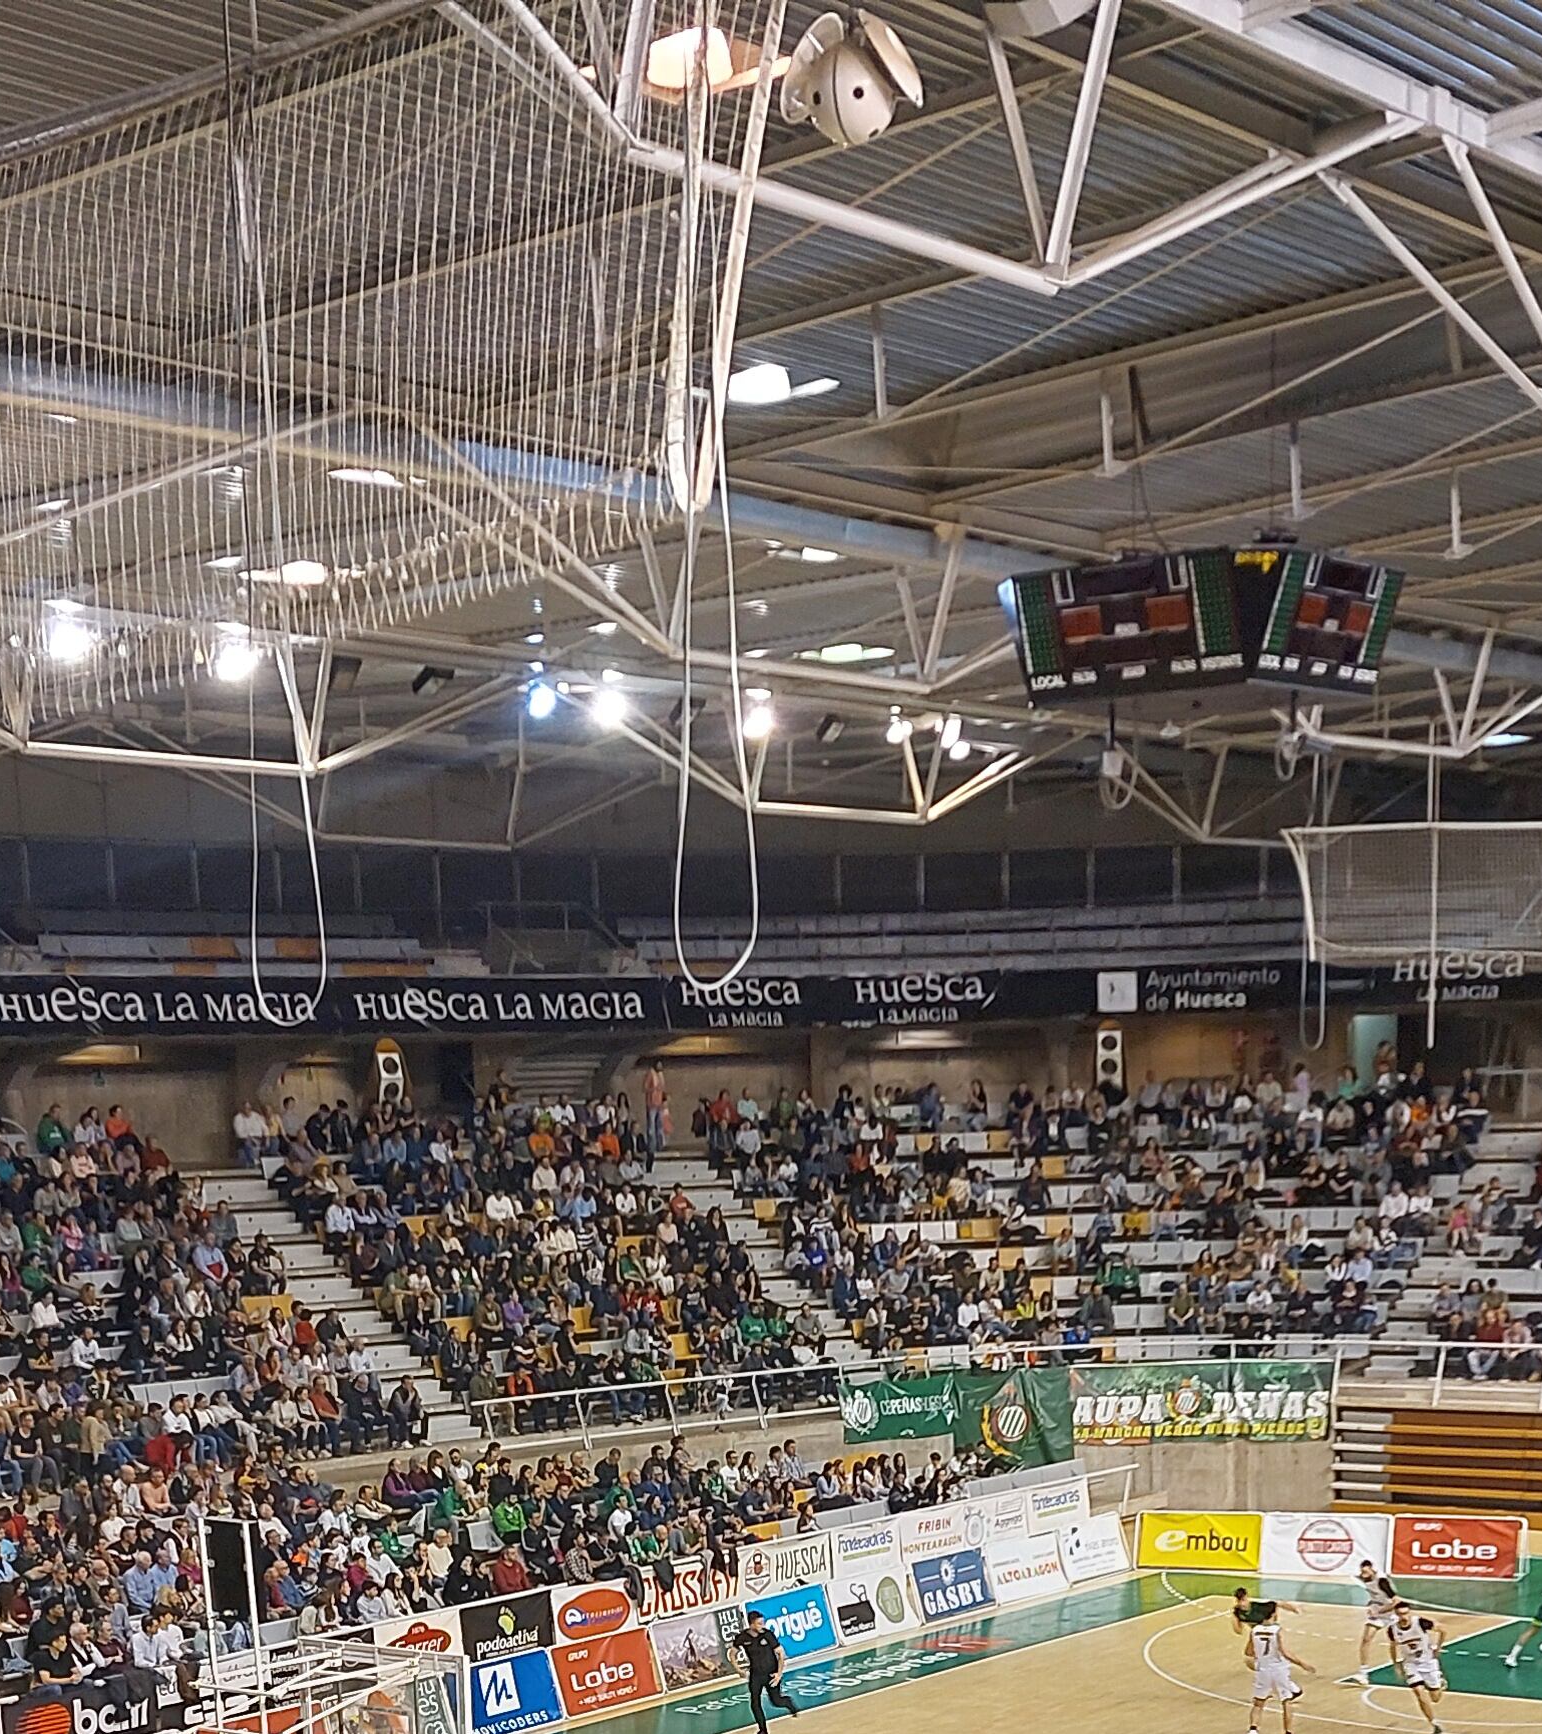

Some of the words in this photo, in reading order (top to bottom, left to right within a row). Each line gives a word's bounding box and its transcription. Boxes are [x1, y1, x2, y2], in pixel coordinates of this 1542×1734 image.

[1146, 965, 1282, 989] Ayuntamiento
[1147, 990, 1169, 1011] de
[1174, 990, 1247, 1010] Huesca
[917, 1518, 952, 1533] FRIBIN
[1154, 1528, 1248, 1552] embou
[1412, 1538, 1497, 1560] Lobe
[775, 1545, 827, 1582] HUESCA
[923, 1579, 984, 1616] GASBY
[570, 1662, 634, 1691] Lobe
